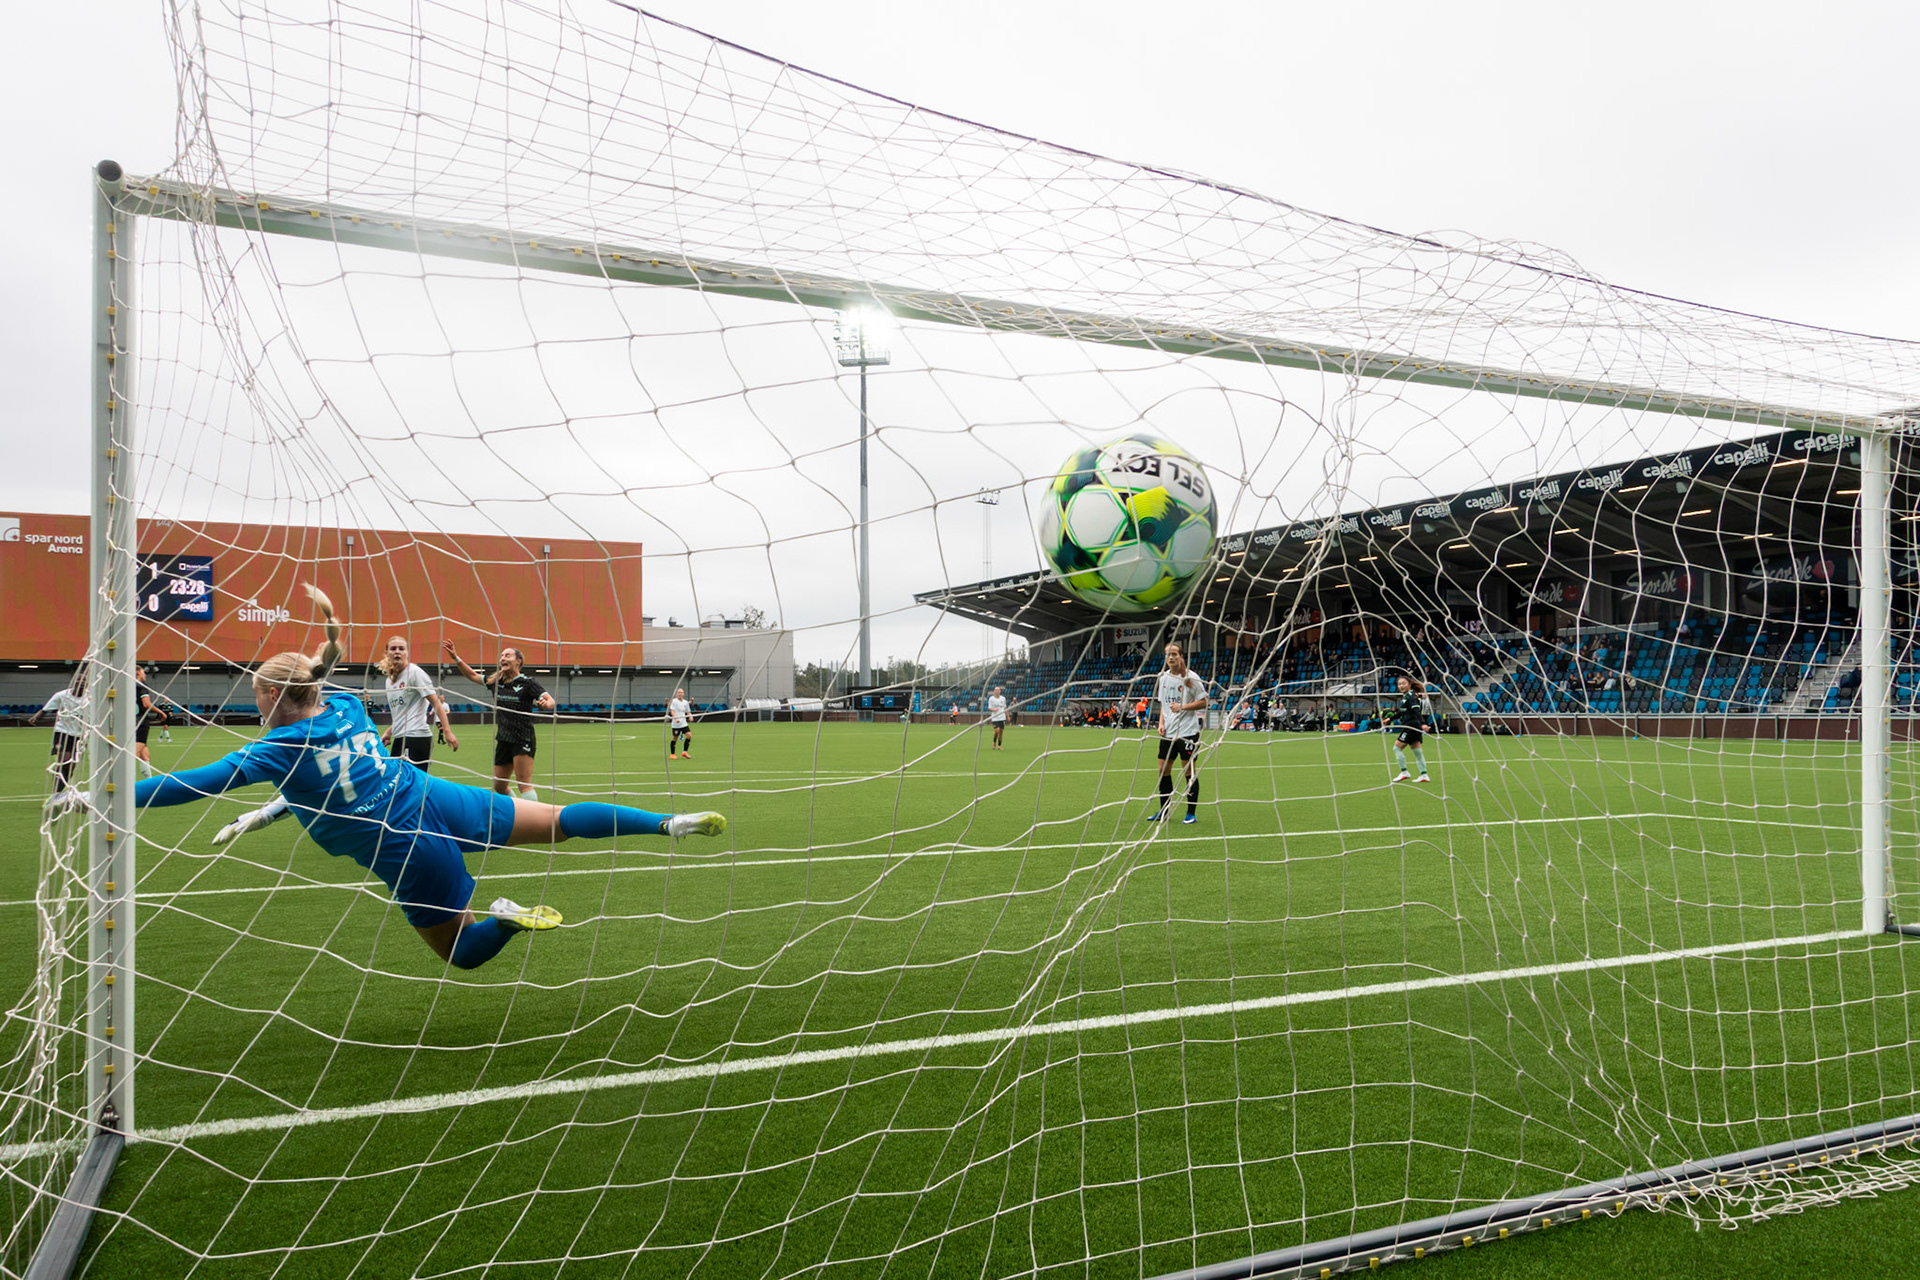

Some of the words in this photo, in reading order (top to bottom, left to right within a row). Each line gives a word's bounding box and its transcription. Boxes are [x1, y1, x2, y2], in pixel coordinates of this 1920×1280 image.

[1714, 442, 1769, 466] capelli
[1112, 453, 1205, 498] SELECT
[1642, 454, 1693, 480] capelli
[1577, 468, 1623, 490] capelli
[1465, 491, 1504, 509] capelli
[1370, 510, 1402, 526] capelli
[1254, 531, 1280, 545] capelli
[48, 544, 83, 554] Arena
[170, 579, 206, 595] 23:28
[149, 594, 159, 611] 0
[238, 605, 290, 626] simple
[314, 731, 387, 804] 77
